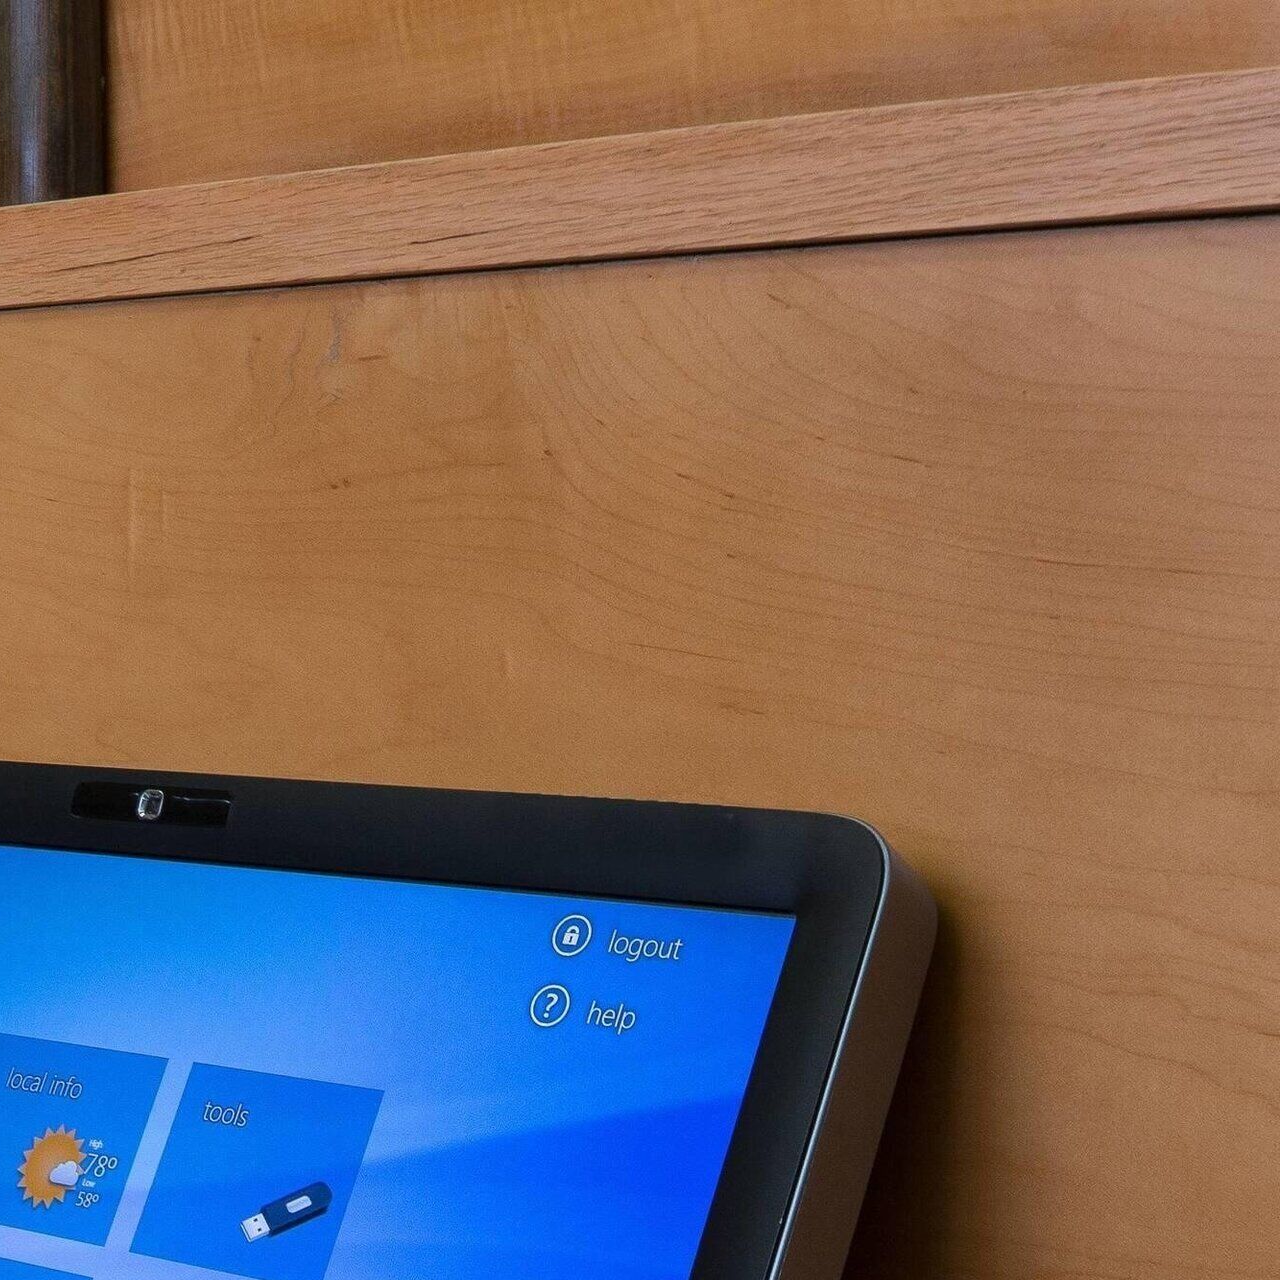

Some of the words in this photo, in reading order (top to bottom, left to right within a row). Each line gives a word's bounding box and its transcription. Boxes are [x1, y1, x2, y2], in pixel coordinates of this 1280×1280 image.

[608, 929, 684, 963] logout
[586, 1000, 637, 1036] help
[6, 1067, 48, 1093] local
[49, 1073, 83, 1100] info
[203, 1101, 249, 1128] tools
